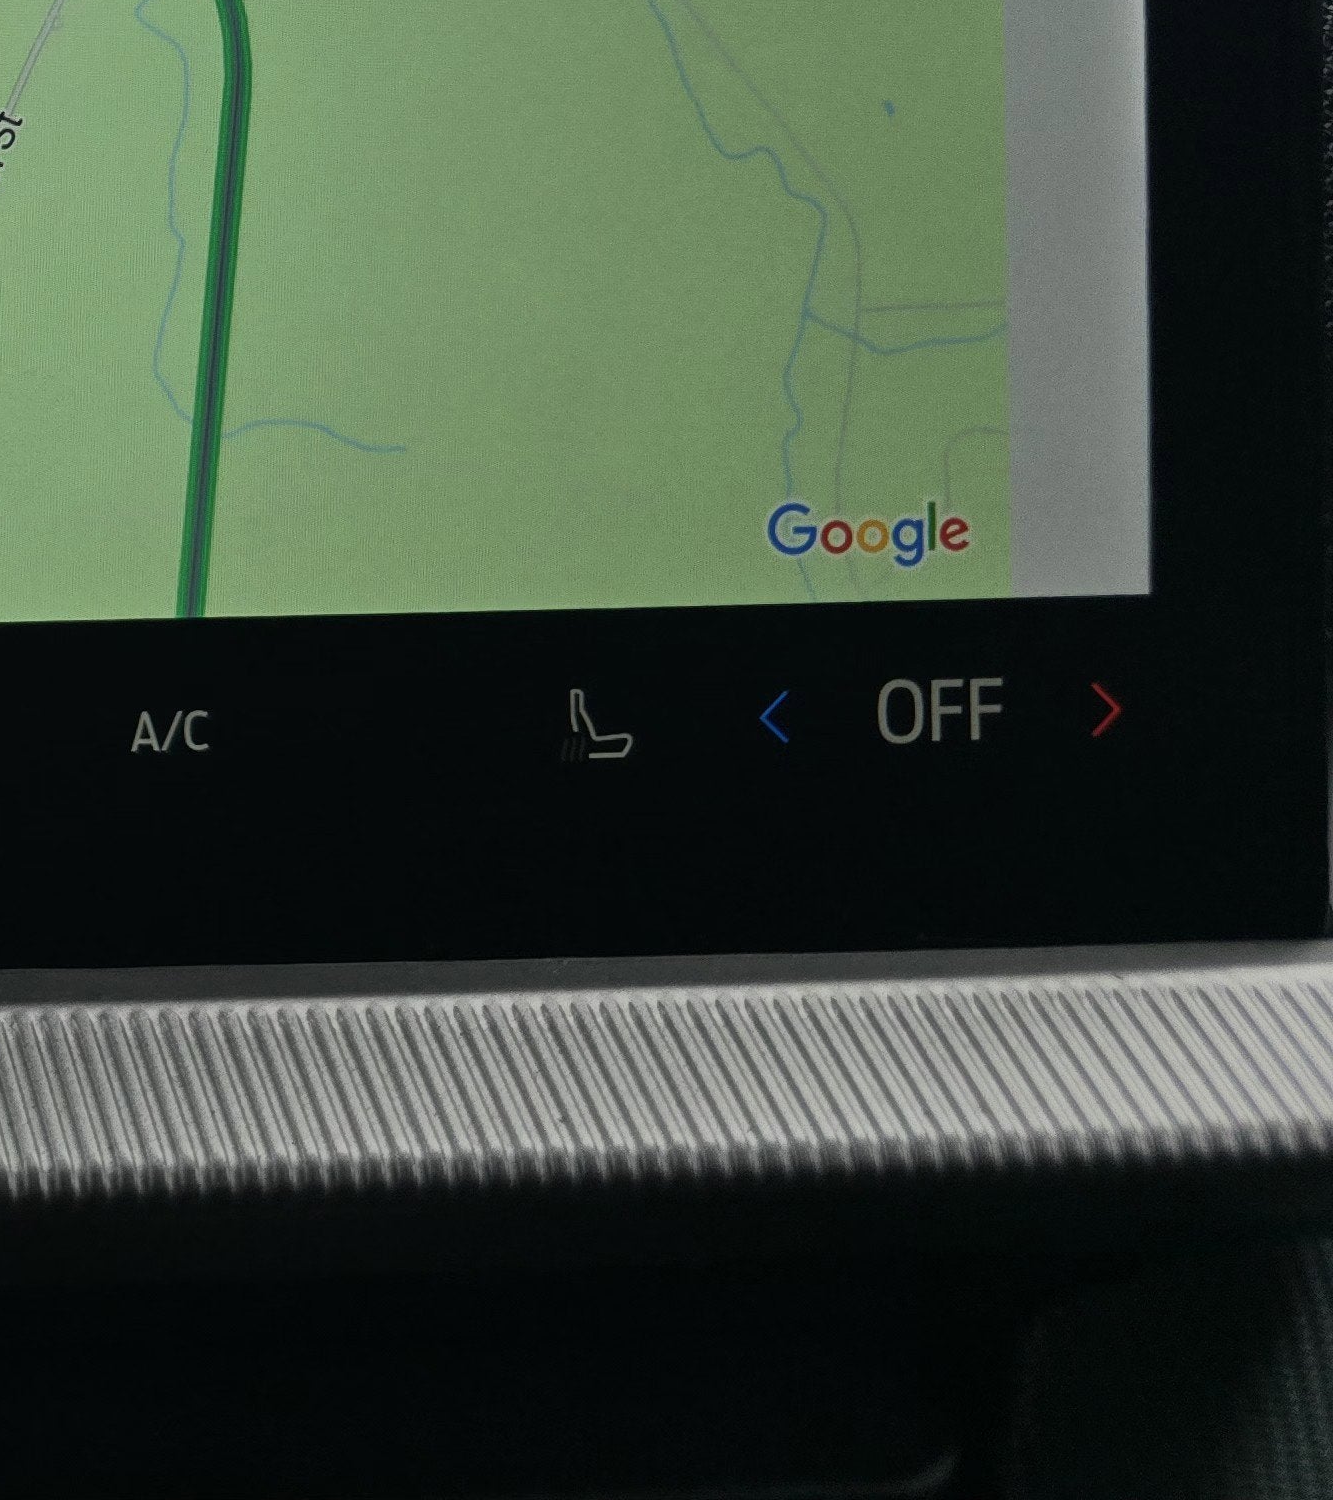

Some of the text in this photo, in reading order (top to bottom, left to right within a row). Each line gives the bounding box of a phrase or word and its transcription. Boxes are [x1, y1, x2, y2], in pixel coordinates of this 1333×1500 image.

[766, 501, 971, 568] Google
[129, 709, 210, 753] A/C
[877, 676, 1004, 745] OFF
